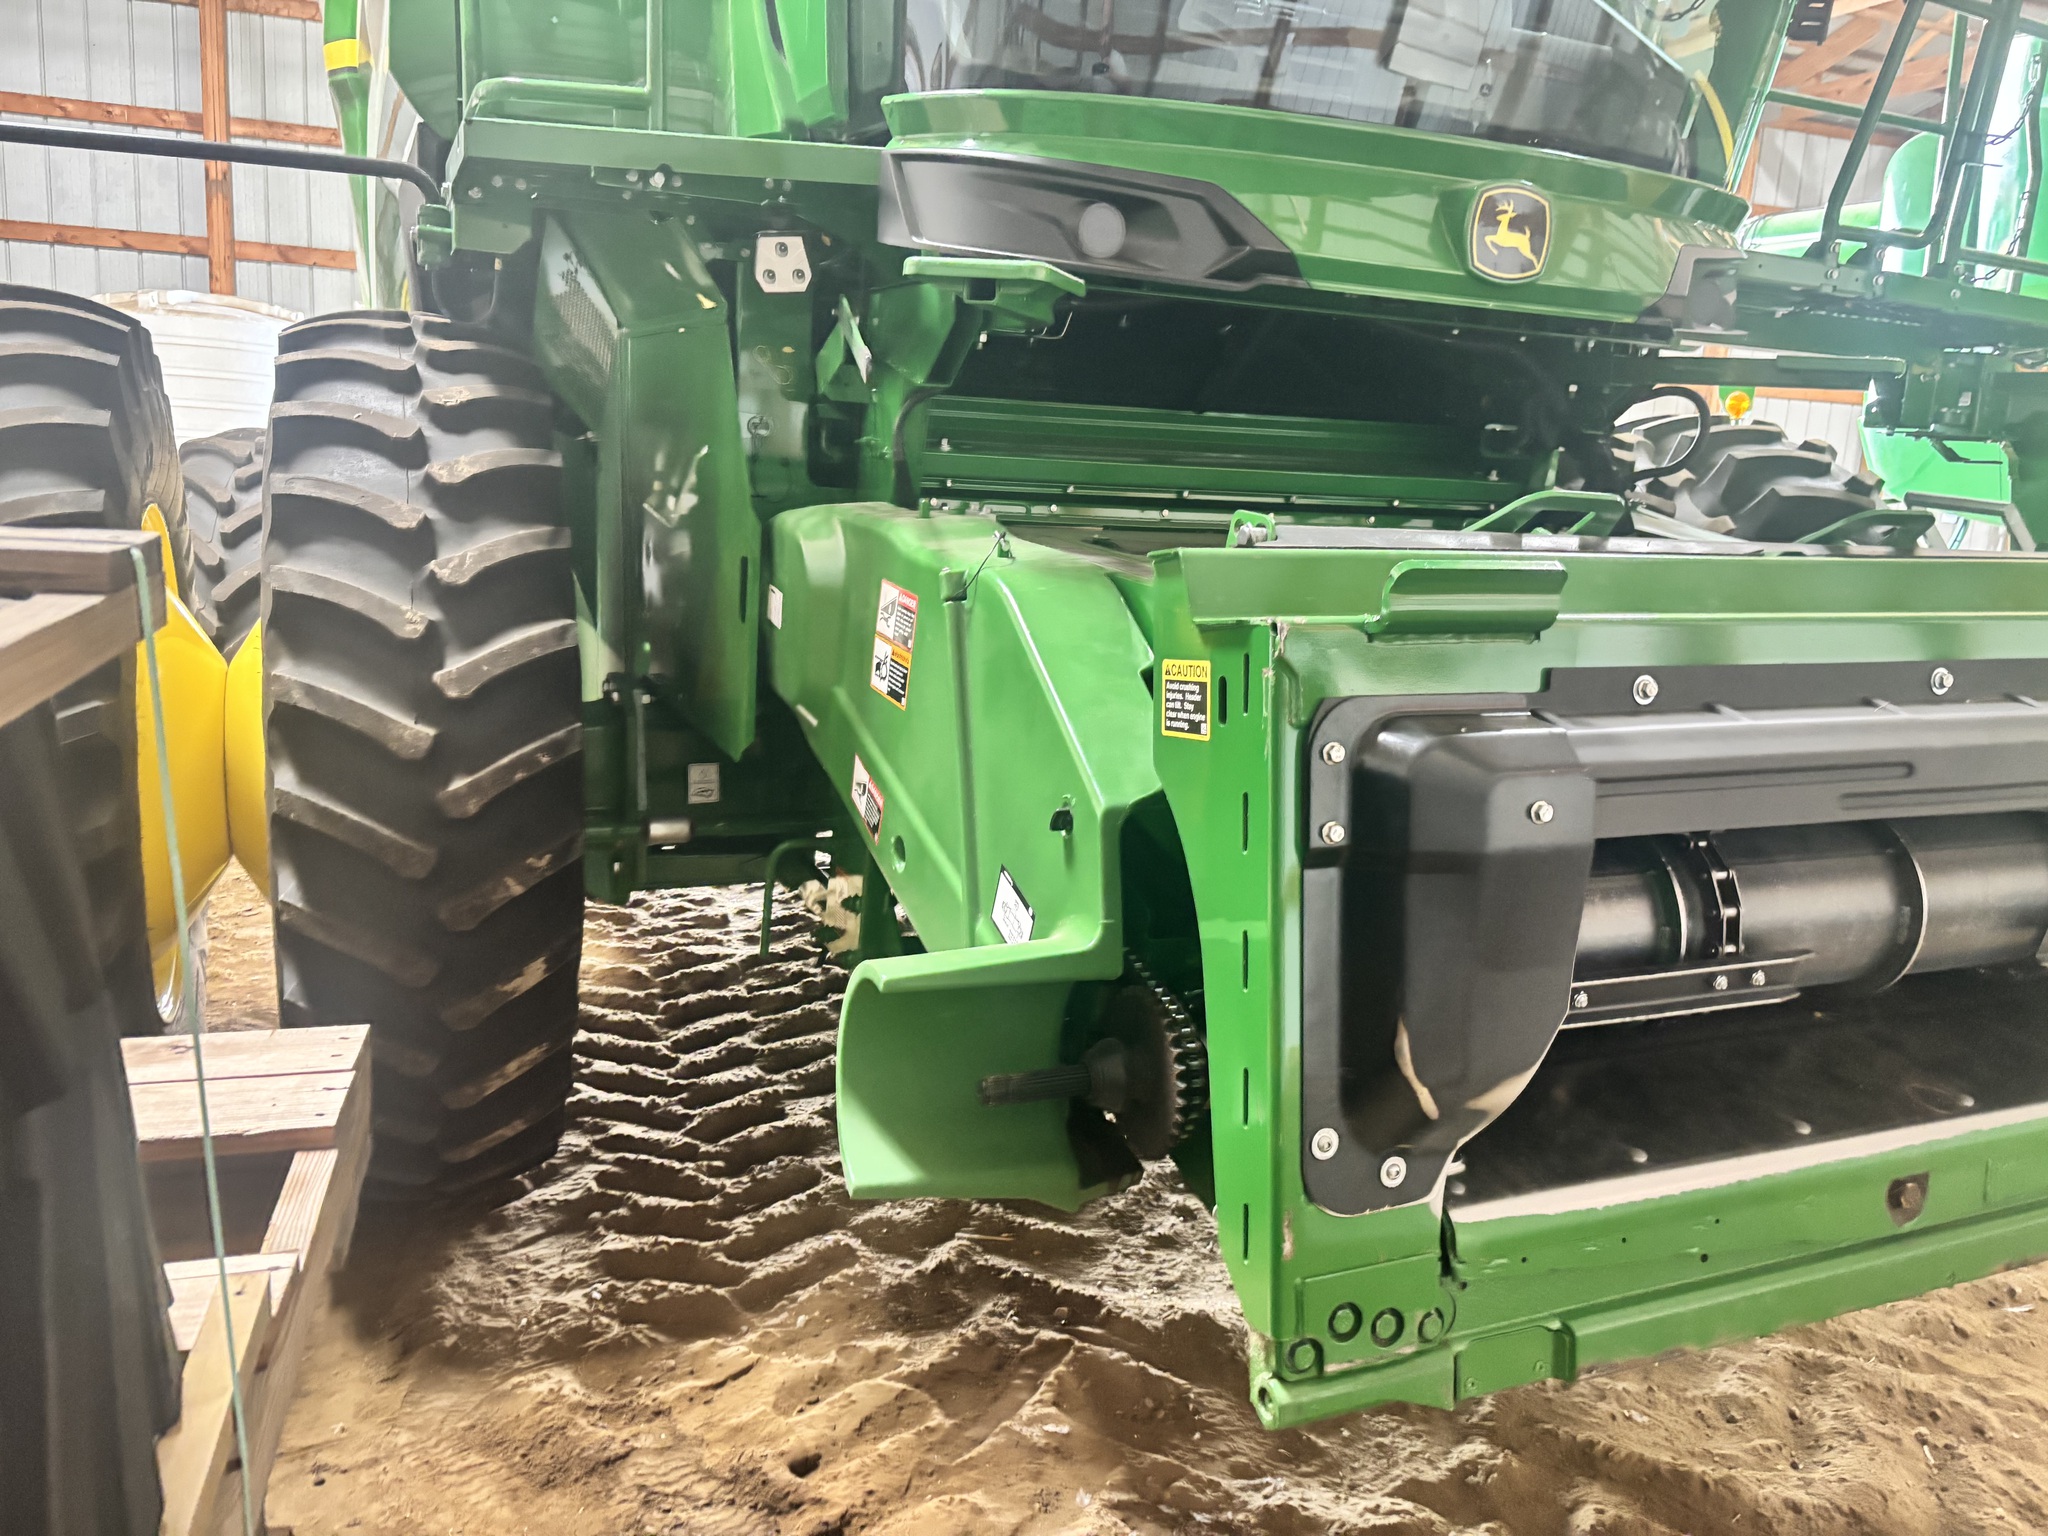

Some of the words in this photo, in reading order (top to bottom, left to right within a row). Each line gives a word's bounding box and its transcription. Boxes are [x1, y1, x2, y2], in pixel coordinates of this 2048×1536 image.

[1171, 664, 1207, 678] CAUTION
[1166, 681, 1179, 690] Avoid
[1190, 712, 1206, 722] engine
